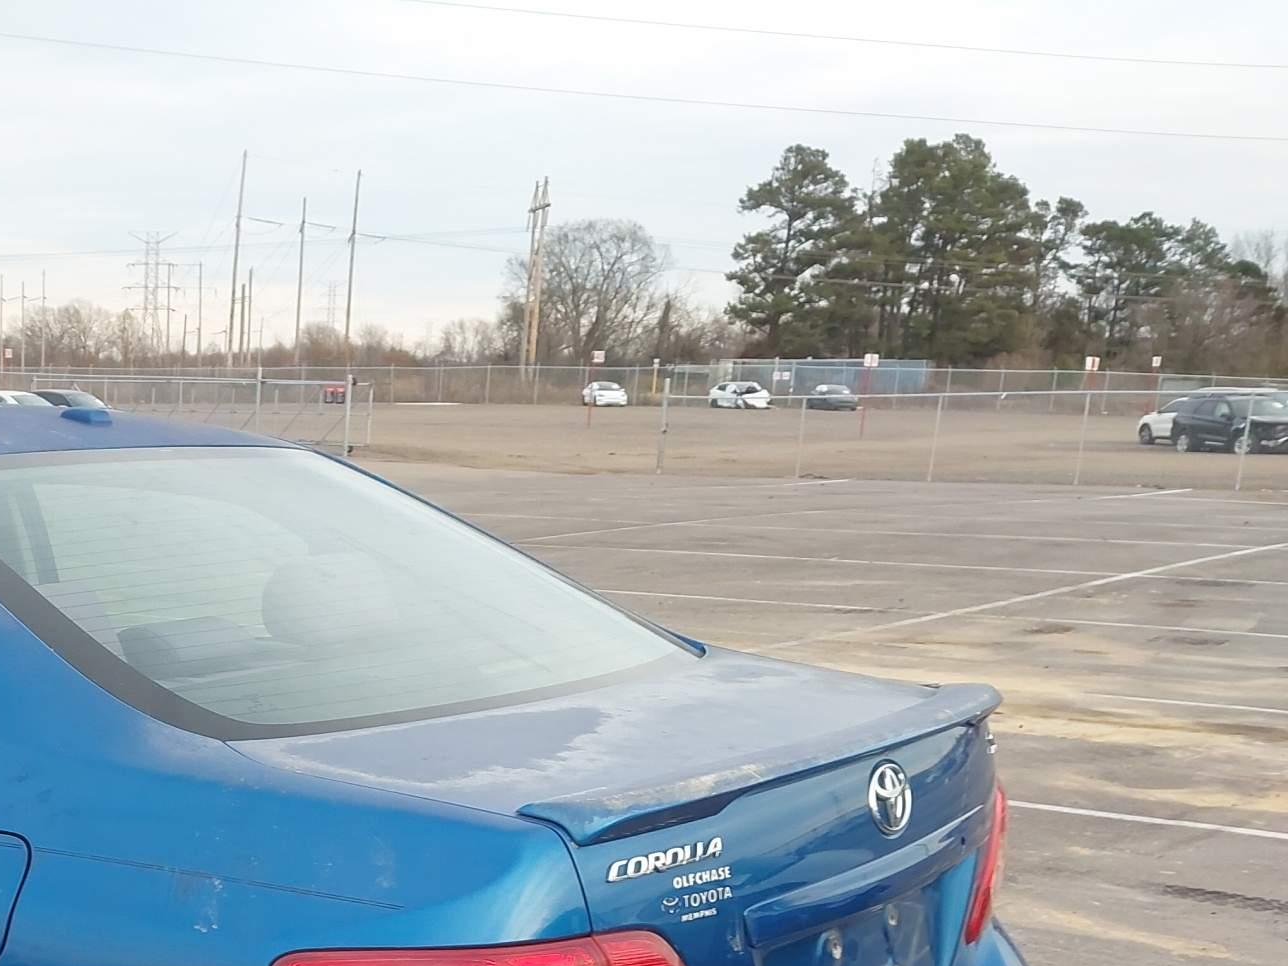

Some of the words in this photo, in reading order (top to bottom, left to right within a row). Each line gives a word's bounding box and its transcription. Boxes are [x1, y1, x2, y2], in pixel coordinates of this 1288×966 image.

[607, 837, 723, 882] COROLLA
[672, 866, 732, 889] OLFCHASE
[682, 886, 732, 907] TOYOTA
